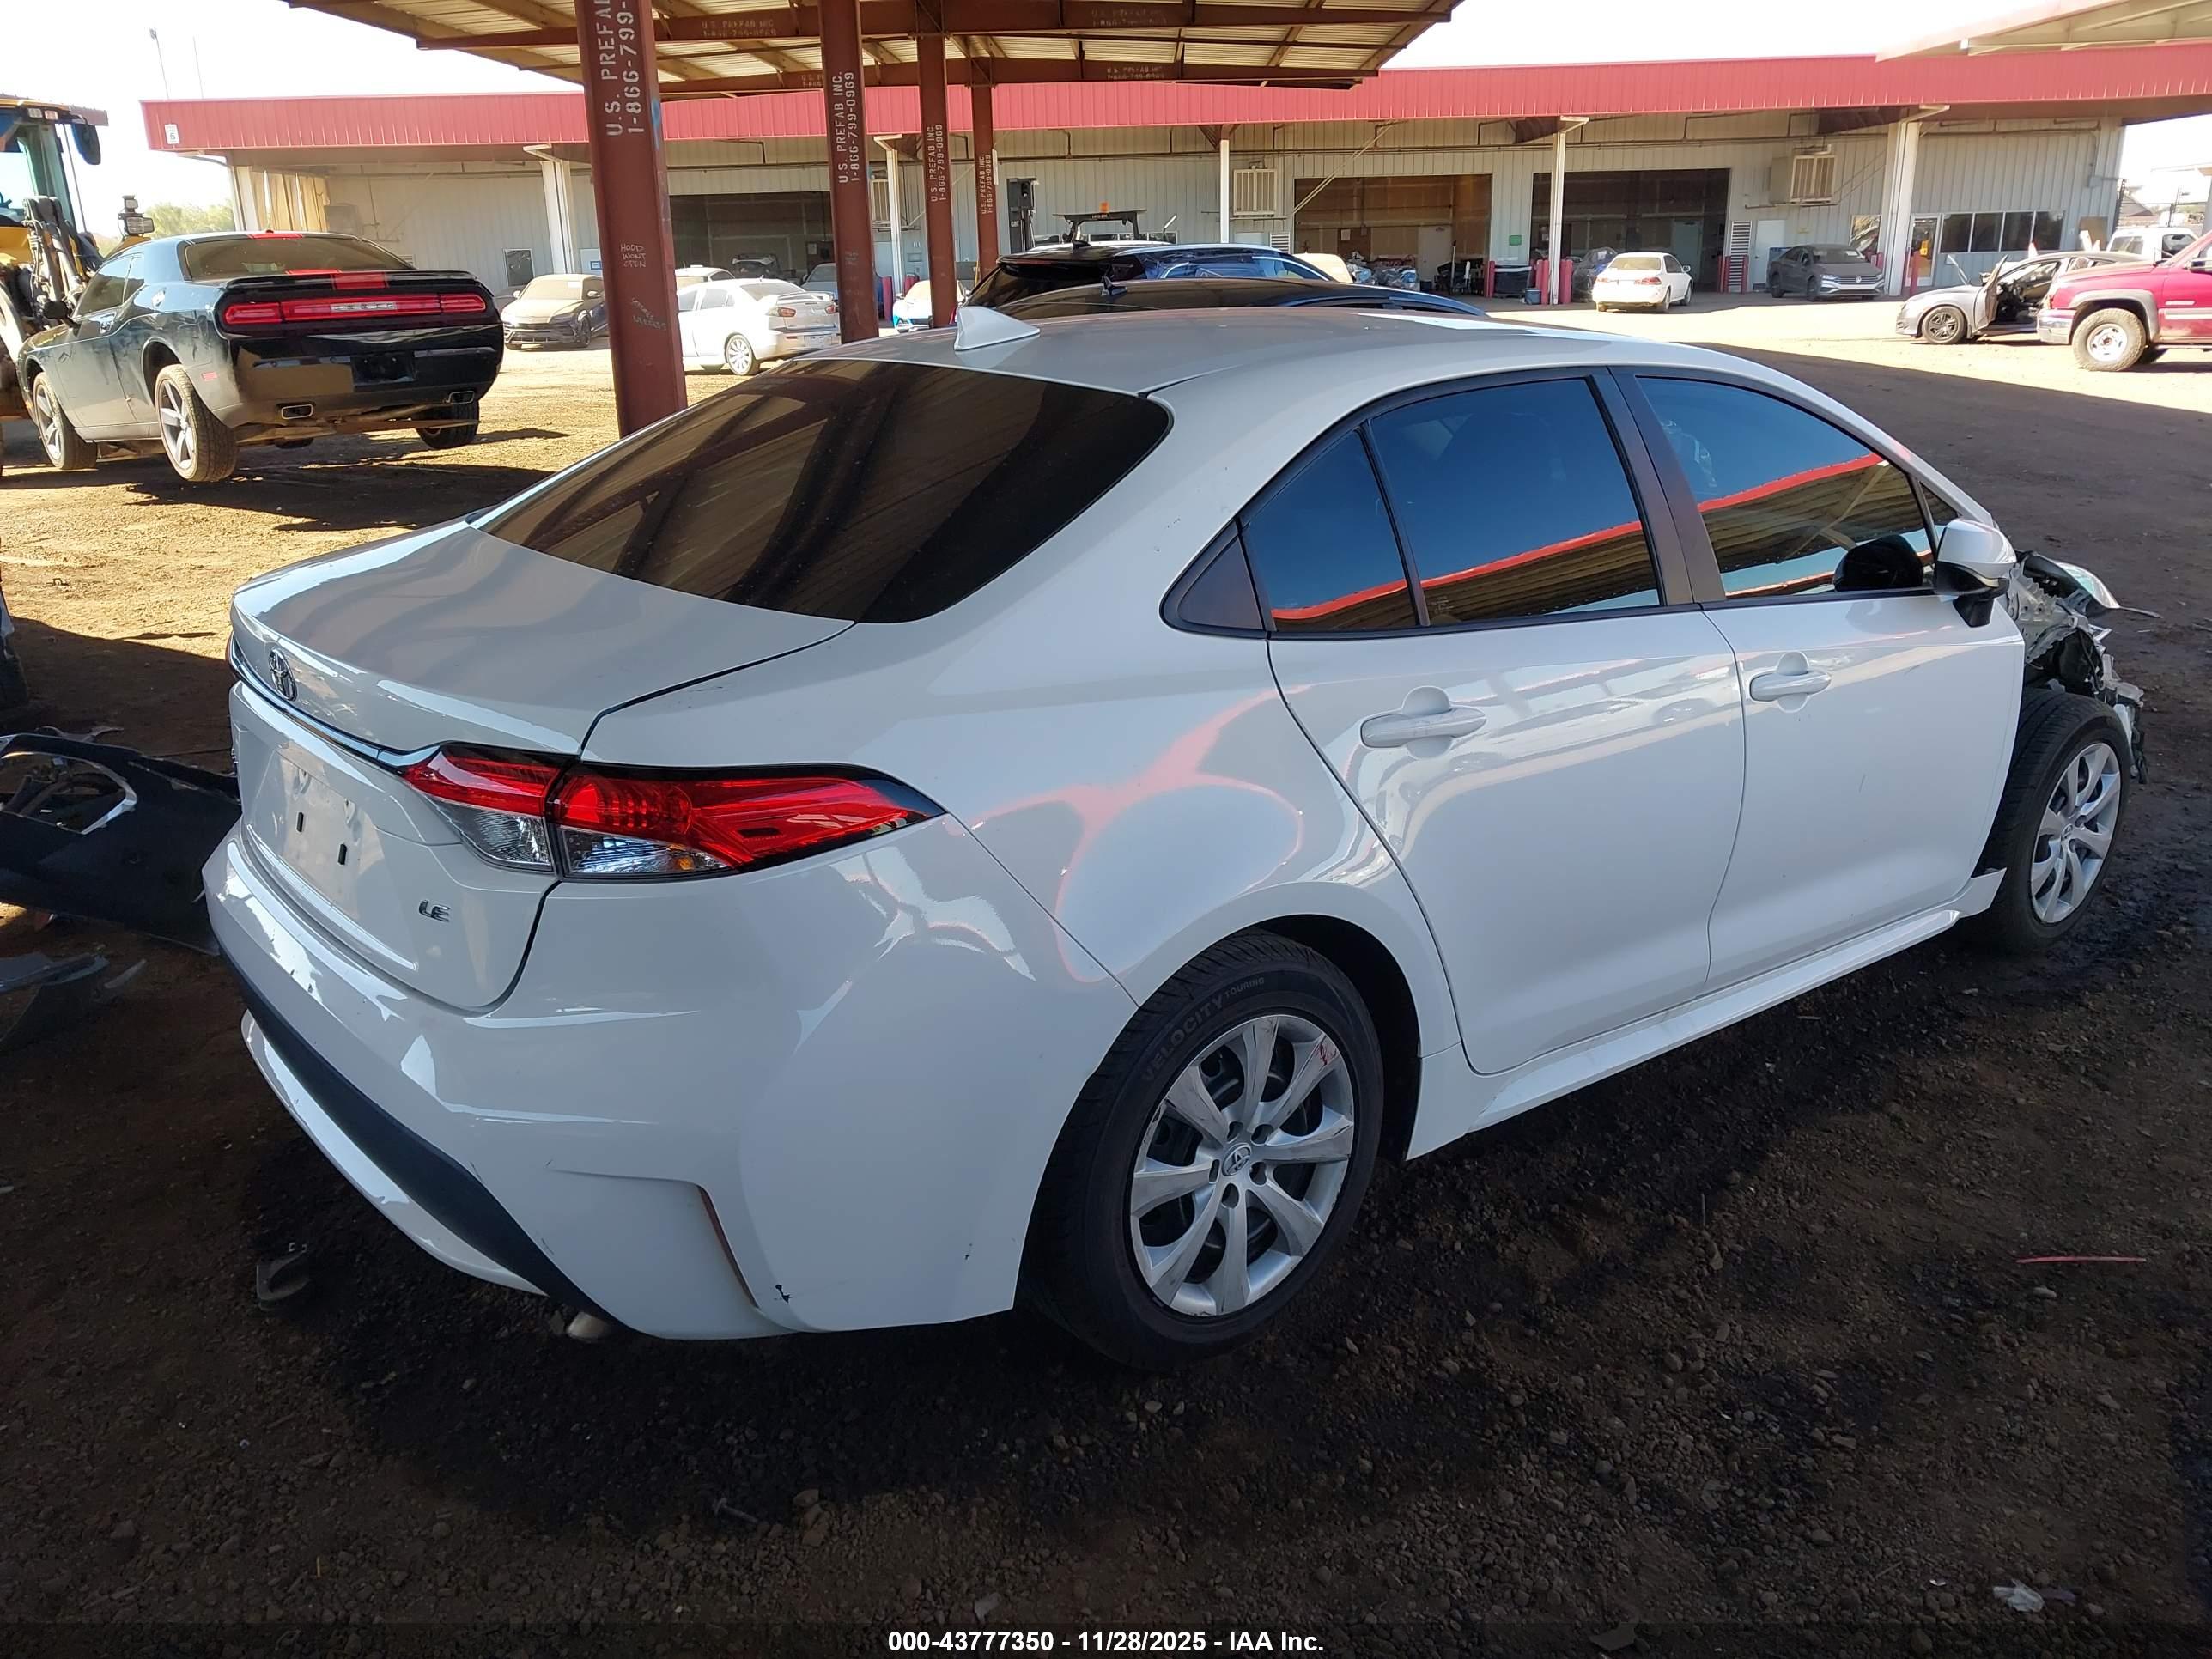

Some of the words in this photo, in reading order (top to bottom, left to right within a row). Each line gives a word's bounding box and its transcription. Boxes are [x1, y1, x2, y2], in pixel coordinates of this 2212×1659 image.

[832, 71, 844, 96] INC.
[605, 94, 623, 136] U.S.
[834, 102, 848, 152] PREFAB
[844, 72, 861, 181] 1-866-799-0969
[838, 160, 849, 183] U.S.
[927, 145, 937, 180] PREFAB
[935, 124, 946, 200] 1-866-799-0969
[418, 899, 451, 922] LE
[1142, 994, 1224, 1080] VELOCITY
[1224, 977, 1265, 998] TOURING
